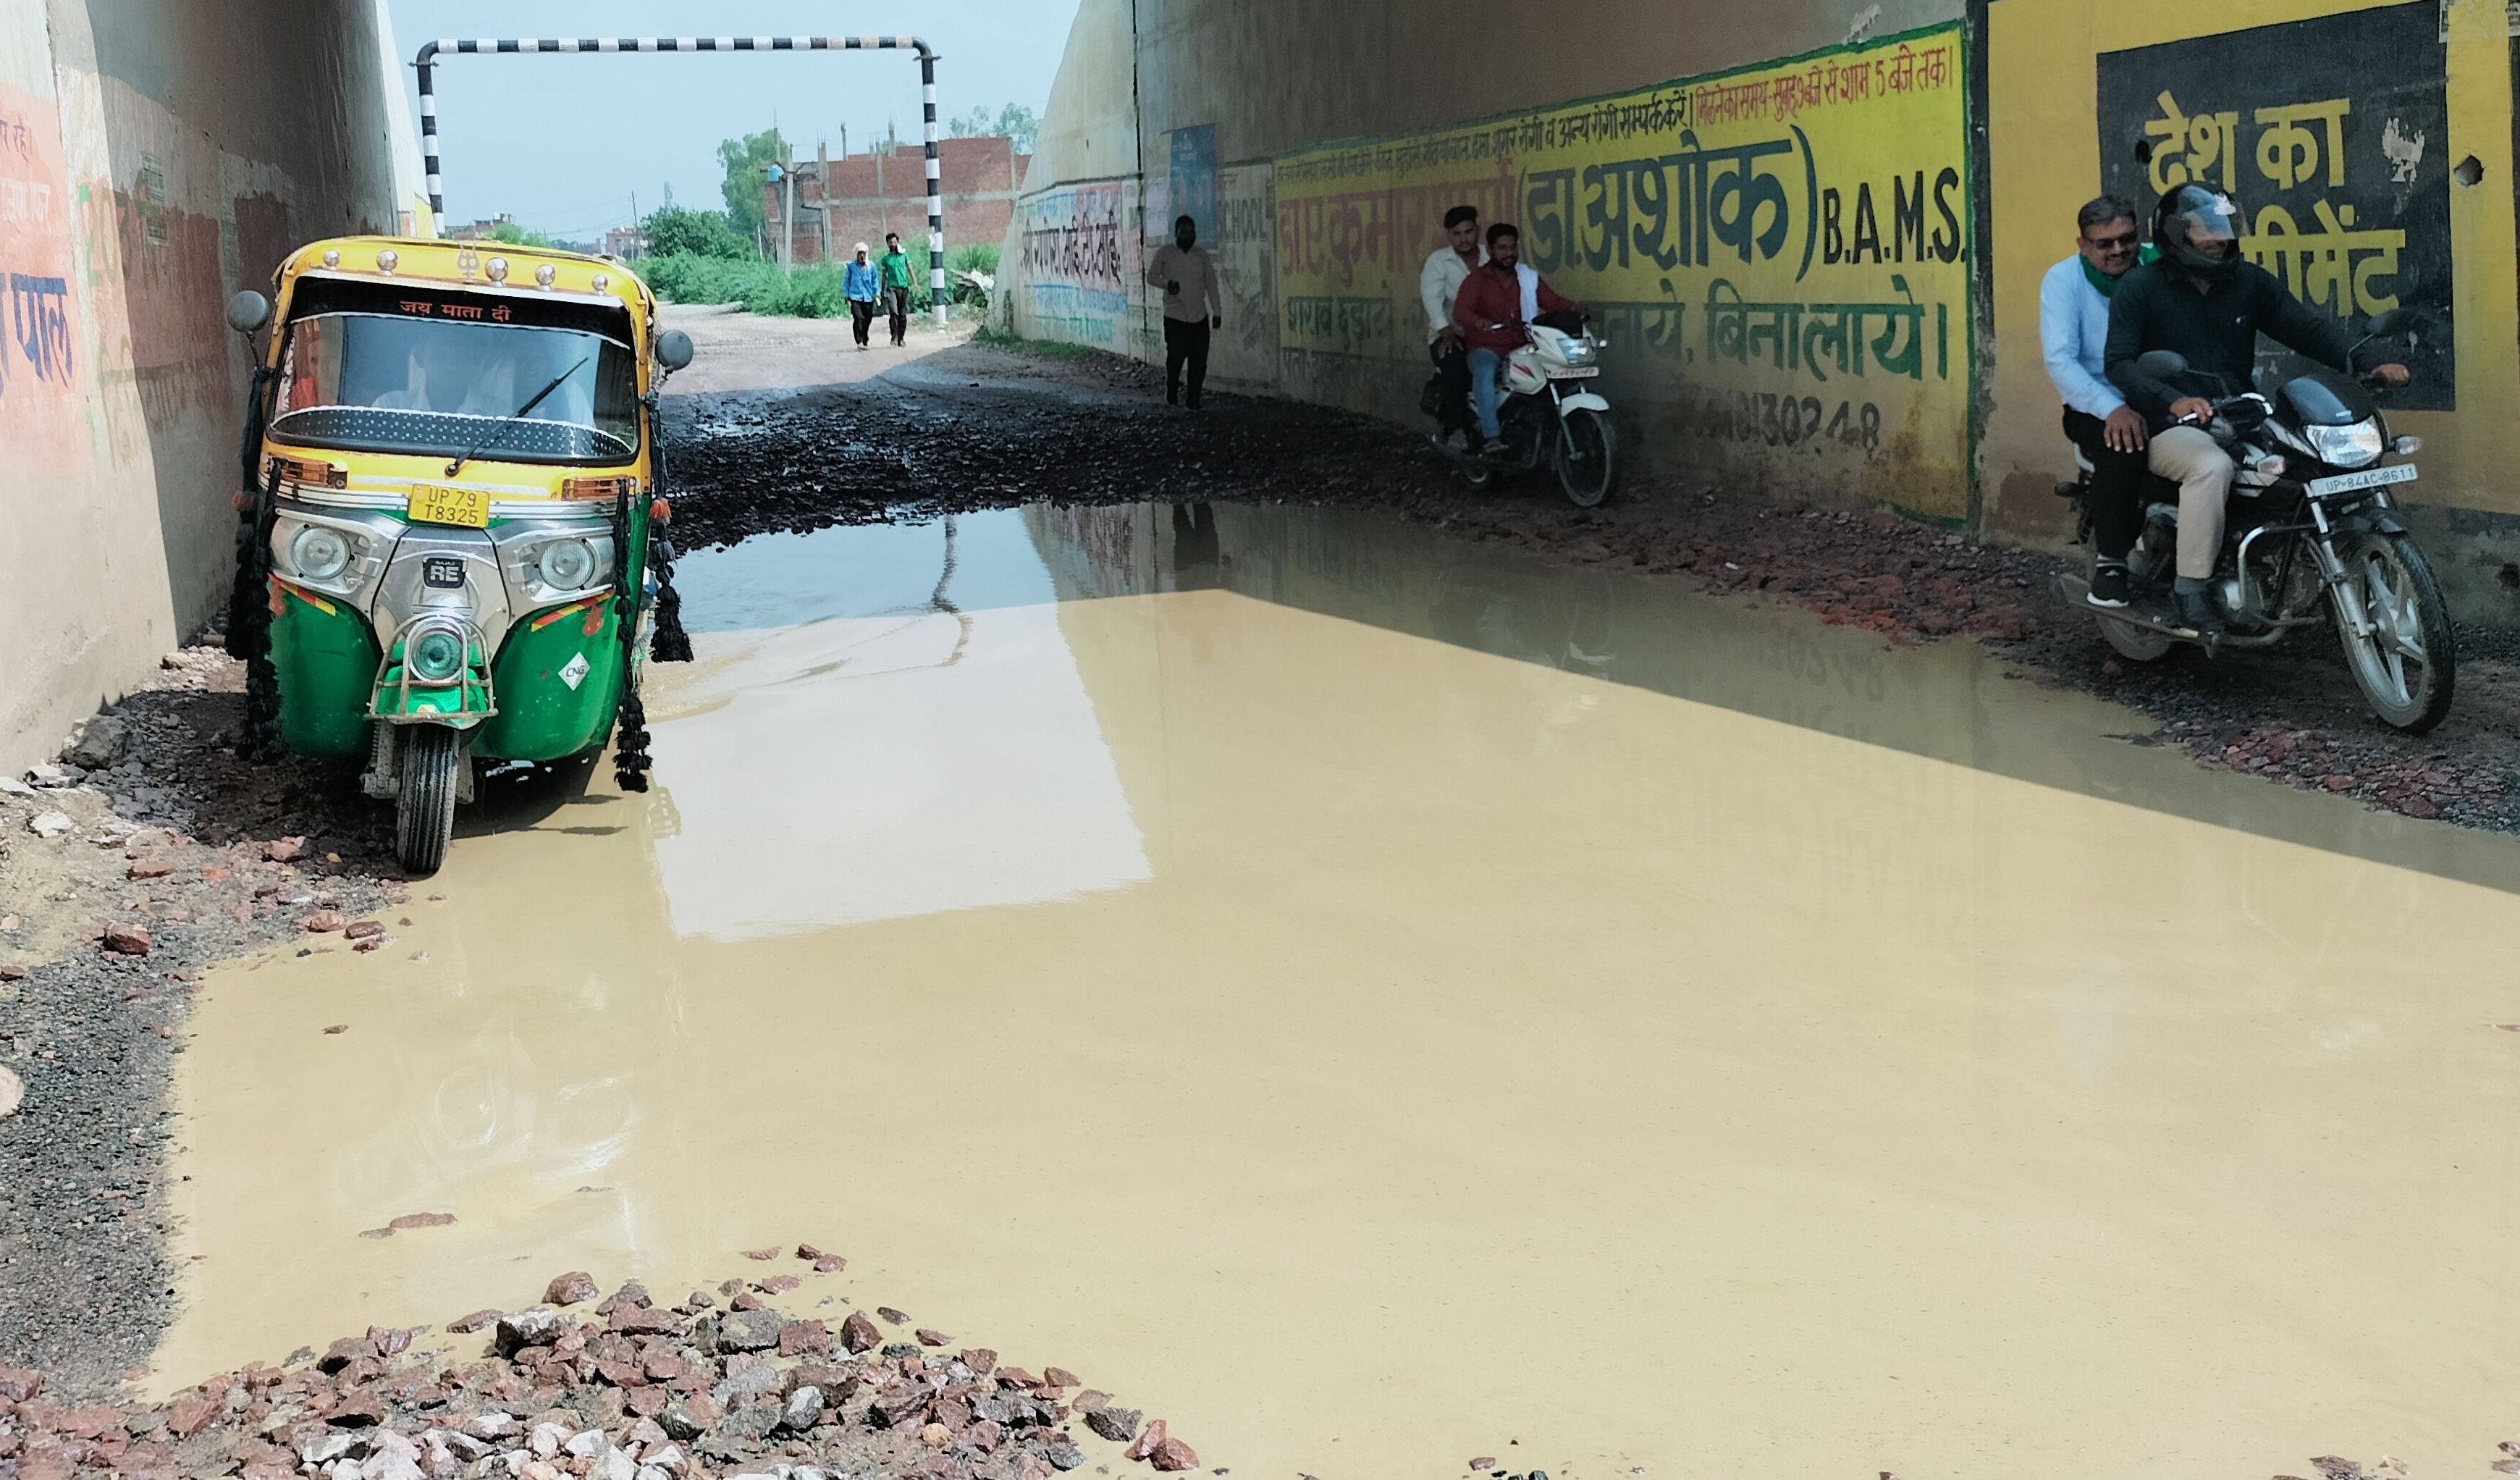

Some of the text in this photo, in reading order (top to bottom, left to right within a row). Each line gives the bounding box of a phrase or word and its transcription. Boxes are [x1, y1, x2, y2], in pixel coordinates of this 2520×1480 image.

[1824, 59, 1837, 106] से
[1840, 62, 1870, 104] शाम
[1875, 59, 1884, 97] 5
[1888, 44, 1916, 96] बजे
[2144, 89, 2351, 196] देश का
[400, 300, 513, 323] जय माता दी
[429, 487, 476, 507] UP 79
[424, 504, 479, 524] T8325
[430, 565, 460, 582] RE
[565, 665, 586, 677] CNG
